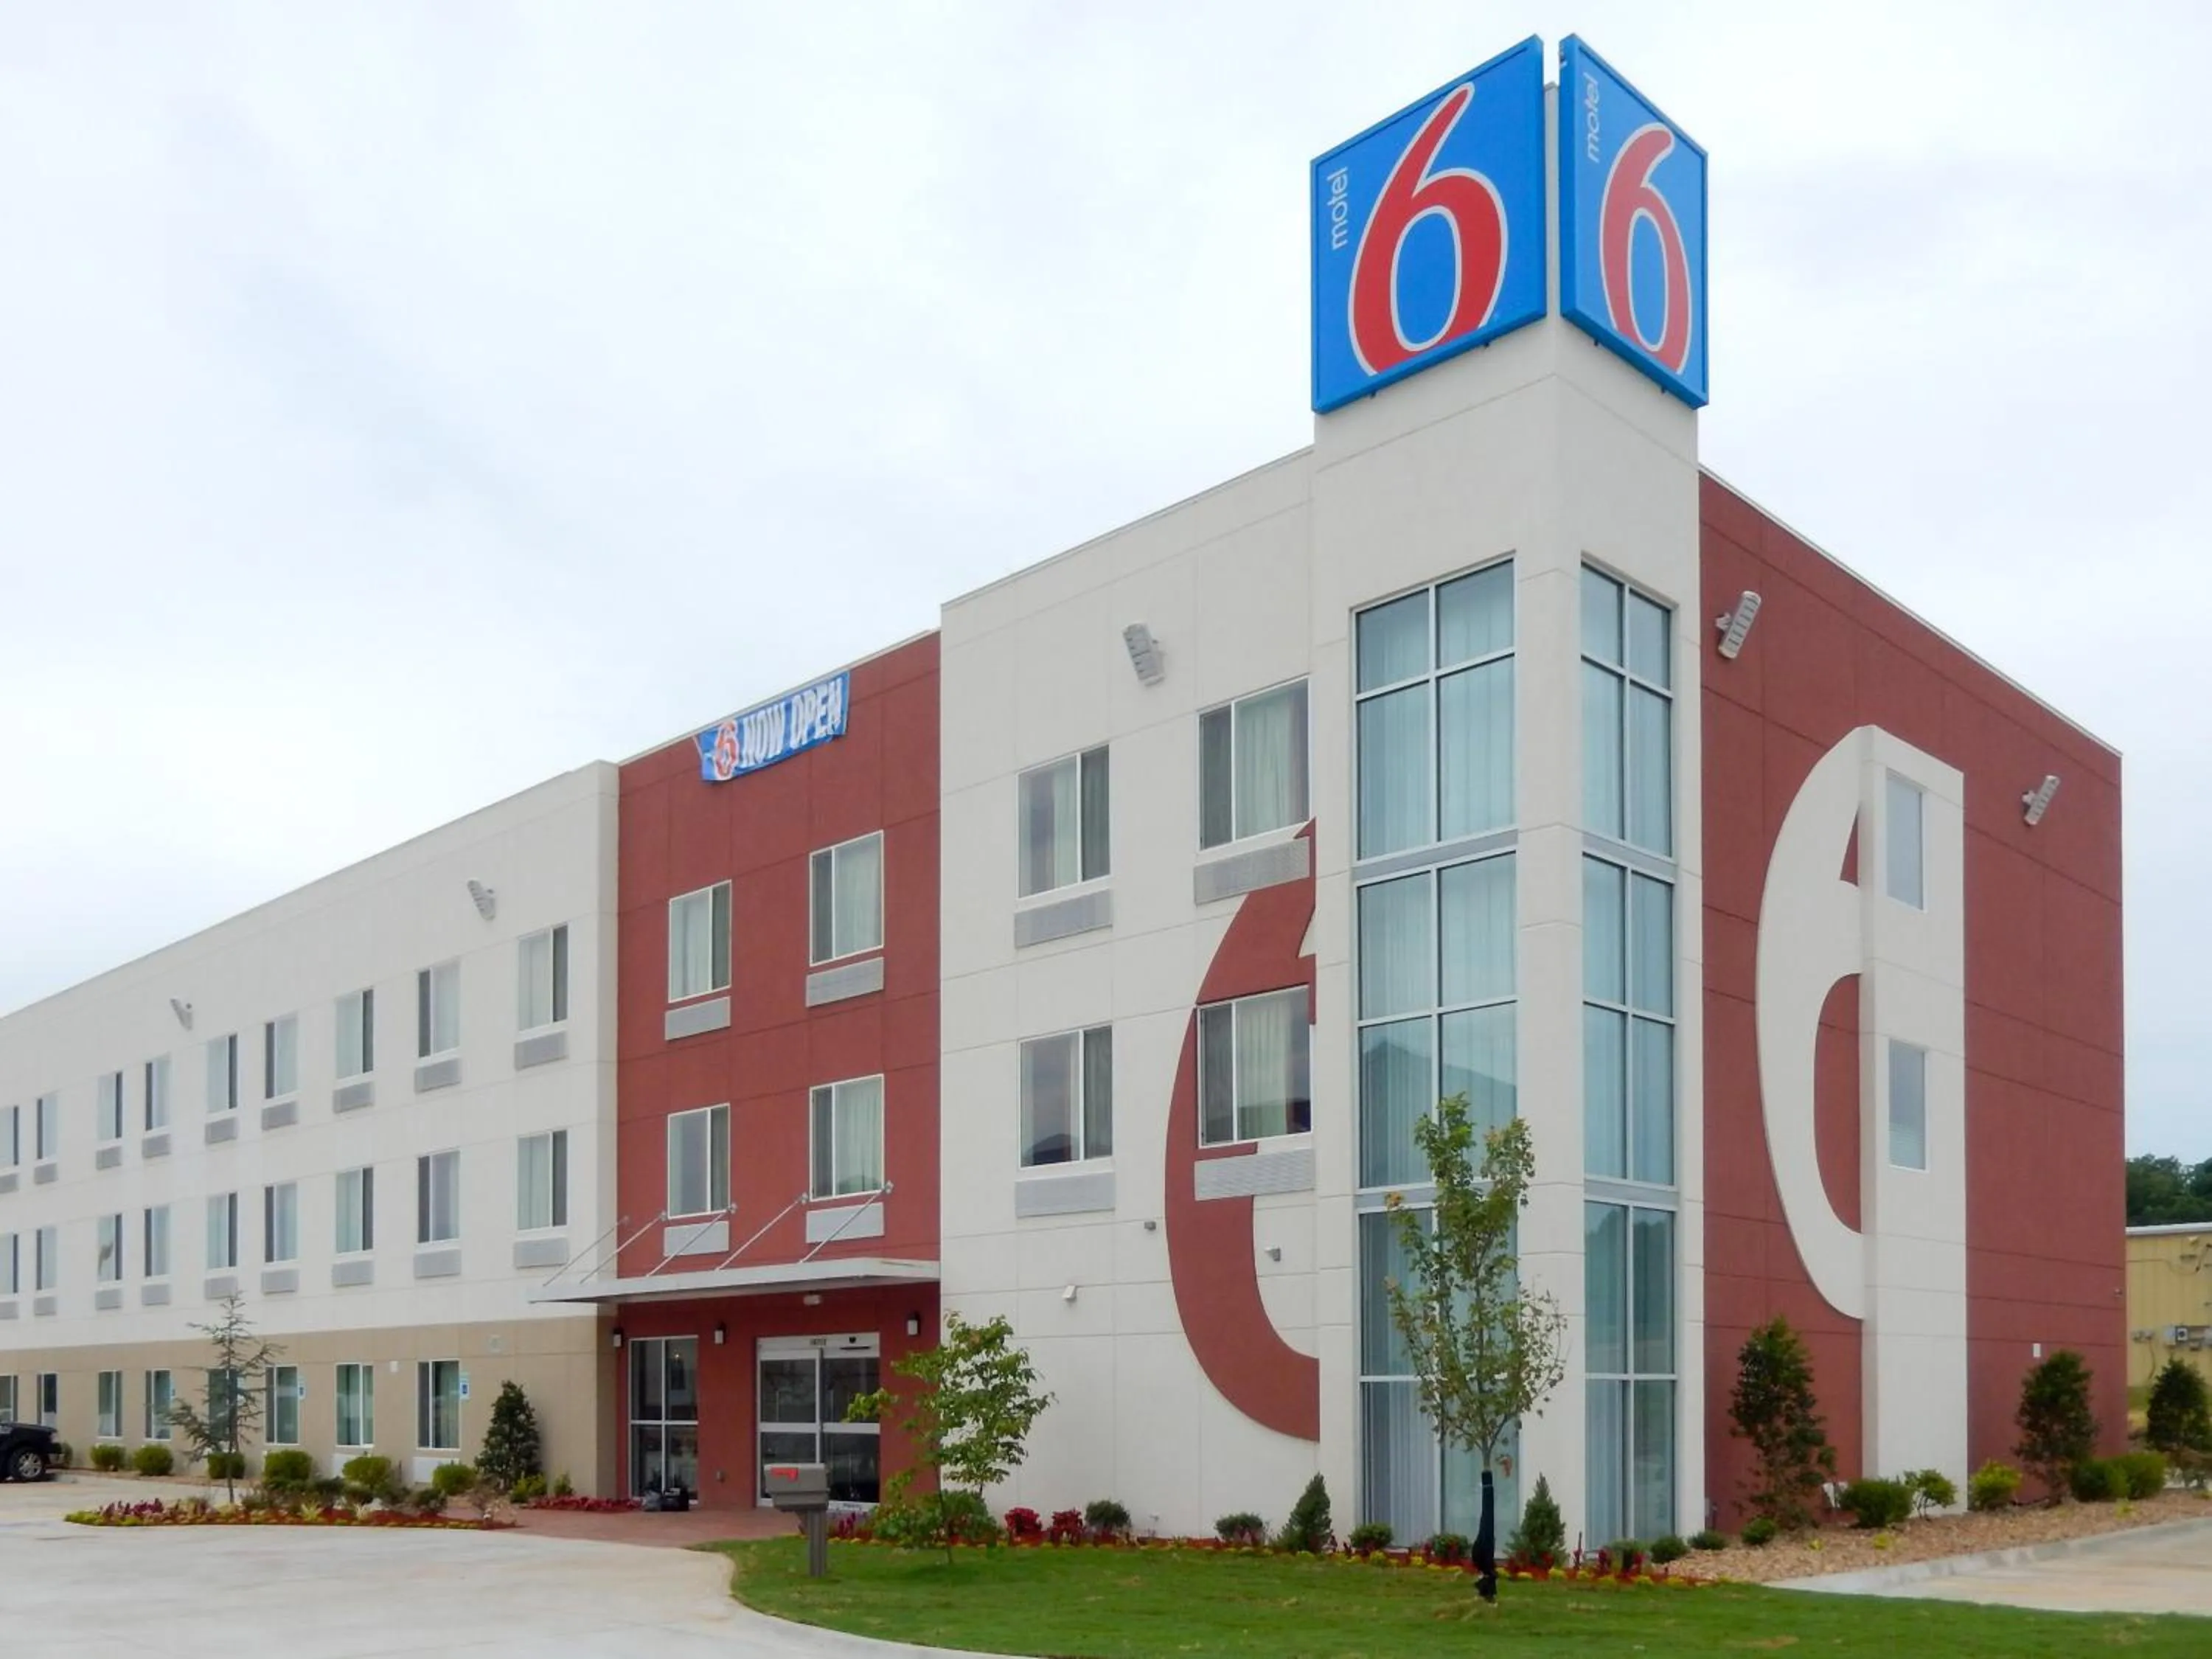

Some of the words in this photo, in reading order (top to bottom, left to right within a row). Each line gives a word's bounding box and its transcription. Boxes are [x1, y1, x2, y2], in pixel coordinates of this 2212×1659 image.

[1326, 166, 1348, 251] motel
[1348, 82, 1509, 377] 6
[1583, 72, 1599, 164] motel
[1599, 122, 1692, 375] 6
[740, 701, 786, 768] NOW
[790, 677, 843, 750] OPEN
